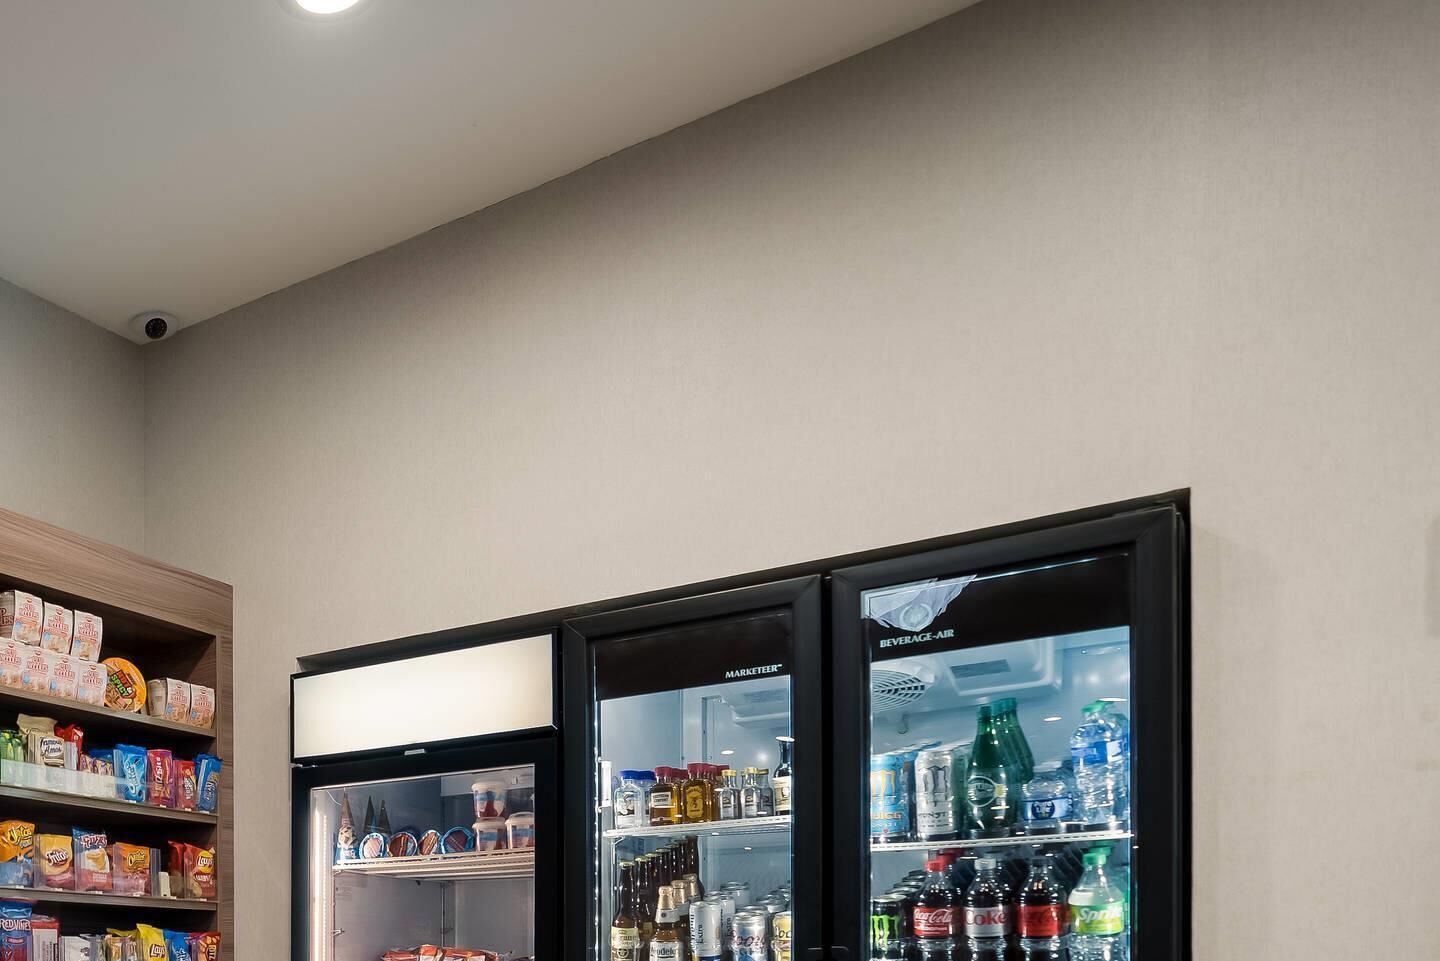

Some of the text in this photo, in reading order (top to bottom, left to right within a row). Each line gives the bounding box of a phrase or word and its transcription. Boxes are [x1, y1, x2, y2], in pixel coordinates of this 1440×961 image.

[879, 629, 955, 648] BEVERAGE-AIR
[111, 673, 129, 697] SPICY
[47, 848, 69, 867] Fritos
[0, 918, 14, 931] RED
[966, 908, 1007, 926] Coke
